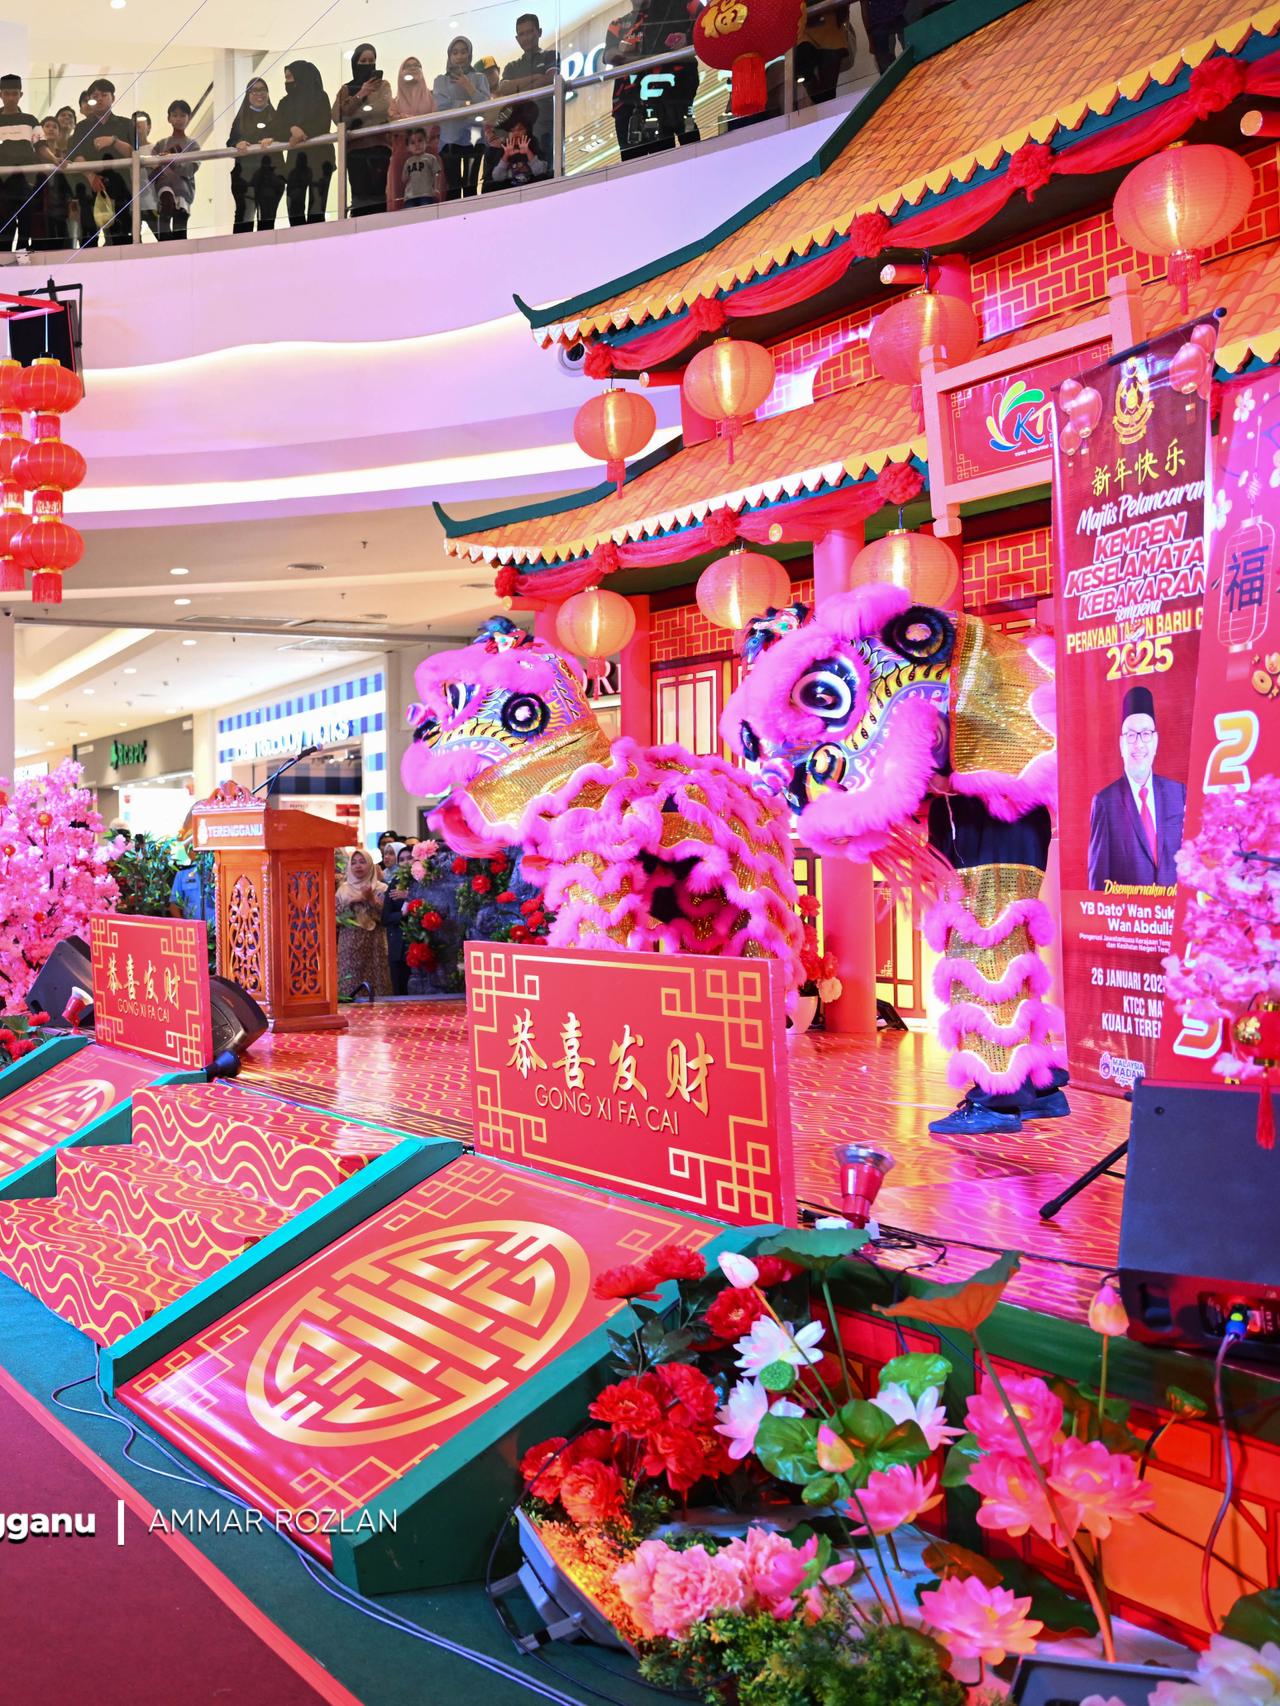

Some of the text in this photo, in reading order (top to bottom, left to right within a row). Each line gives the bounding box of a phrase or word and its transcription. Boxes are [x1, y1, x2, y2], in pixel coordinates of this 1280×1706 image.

[1091, 438, 1186, 497] 新年快乐
[1076, 502, 1118, 536] Majlis
[1092, 511, 1187, 564] KEMPEN
[1225, 545, 1269, 613] 福
[1066, 624, 1118, 655] PERAYAAN
[1156, 608, 1192, 637] BARU
[207, 823, 264, 838] TERENGGANU
[1080, 901, 1095, 915] YB
[1097, 902, 1125, 917] Dato'
[1127, 903, 1152, 918] Wan
[1108, 918, 1131, 933] Wan
[107, 952, 181, 1010] 恭喜发财
[1091, 967, 1104, 985] 26
[1106, 968, 1141, 990] JANUARI
[117, 998, 170, 1023] GONG XI FA CAI
[1101, 1012, 1133, 1035] KUALA
[1123, 995, 1164, 1018] KTCC MA
[505, 1008, 714, 1117] 恭喜发财
[534, 1084, 680, 1136] GONG XI FA CAI
